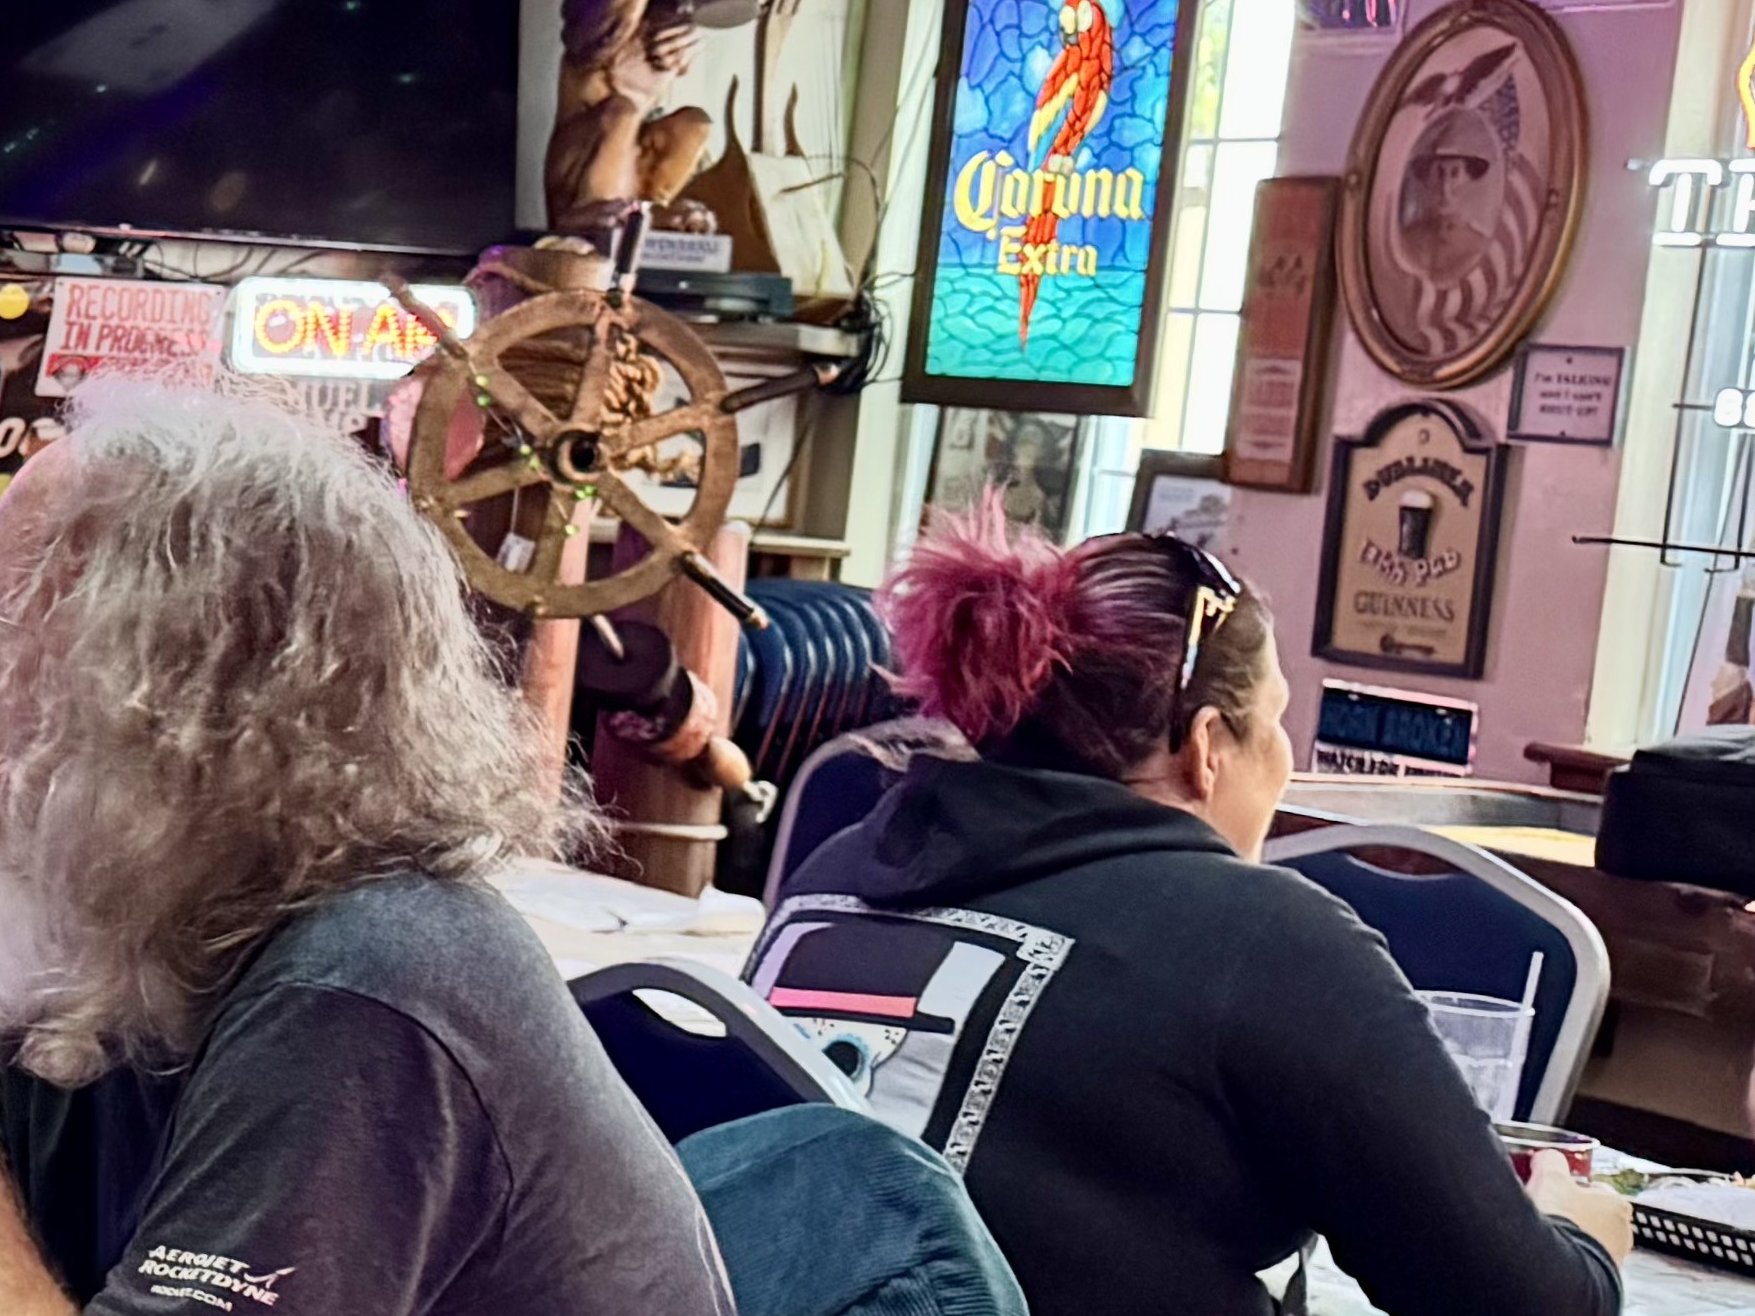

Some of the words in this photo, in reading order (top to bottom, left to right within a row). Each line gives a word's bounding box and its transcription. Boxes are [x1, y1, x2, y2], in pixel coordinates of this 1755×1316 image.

[952, 149, 1145, 241] Corona
[996, 224, 1099, 277] Extra
[66, 283, 213, 322] RECORDING
[59, 322, 87, 349] IN
[254, 298, 353, 356] ON
[1353, 589, 1455, 623] GUINNESS
[147, 1244, 251, 1274] AEROJET
[137, 1258, 280, 1307] ROCKETDYNE
